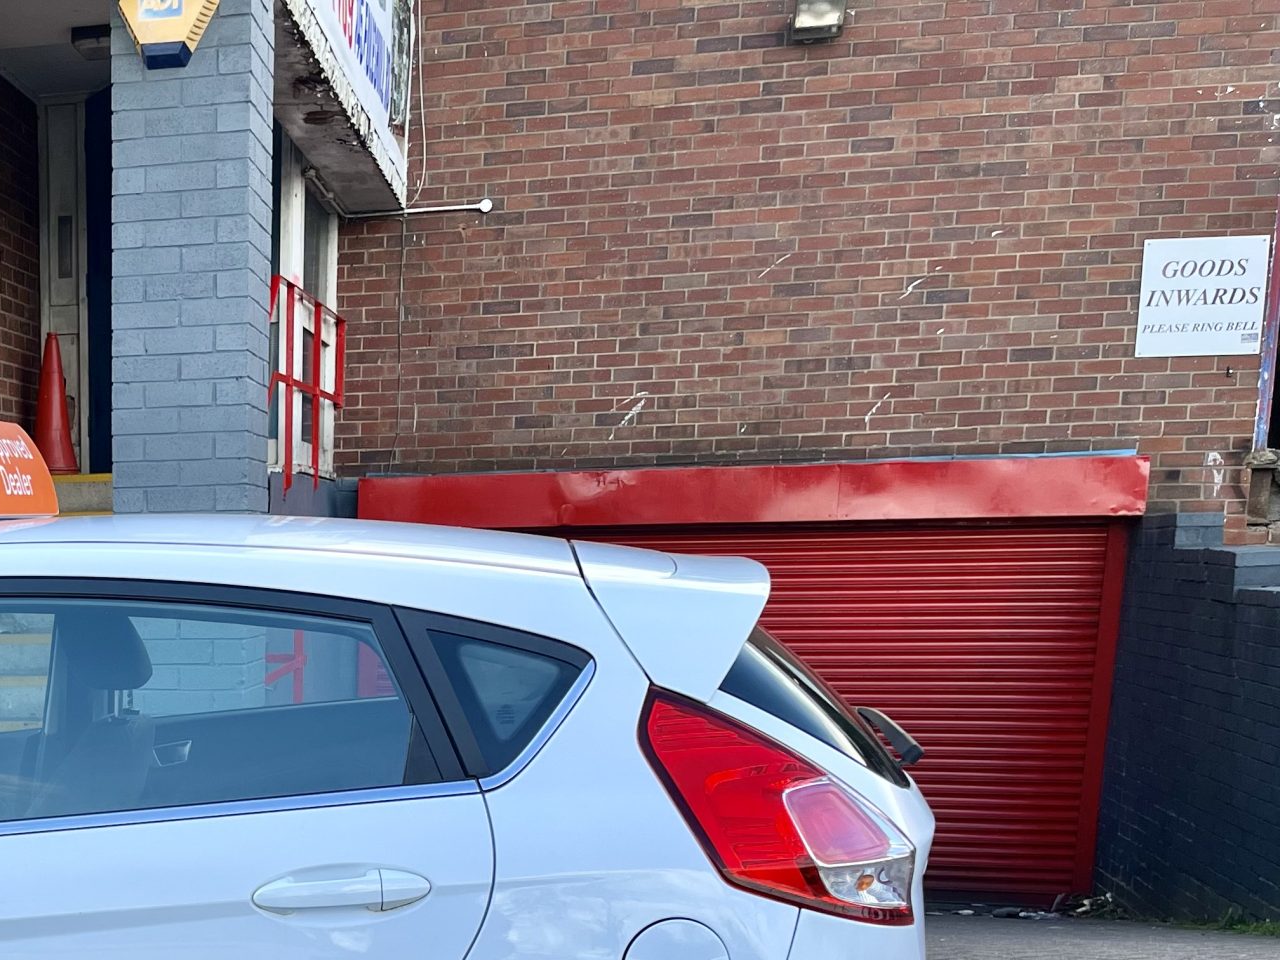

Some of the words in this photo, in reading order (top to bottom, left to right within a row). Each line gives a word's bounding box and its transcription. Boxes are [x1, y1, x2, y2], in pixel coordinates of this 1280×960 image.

[1161, 258, 1249, 279] GOODS
[1145, 286, 1261, 307] INWARDS
[1142, 323, 1190, 334] PLEASE
[1191, 322, 1224, 333] RING
[1226, 321, 1259, 332] BELL
